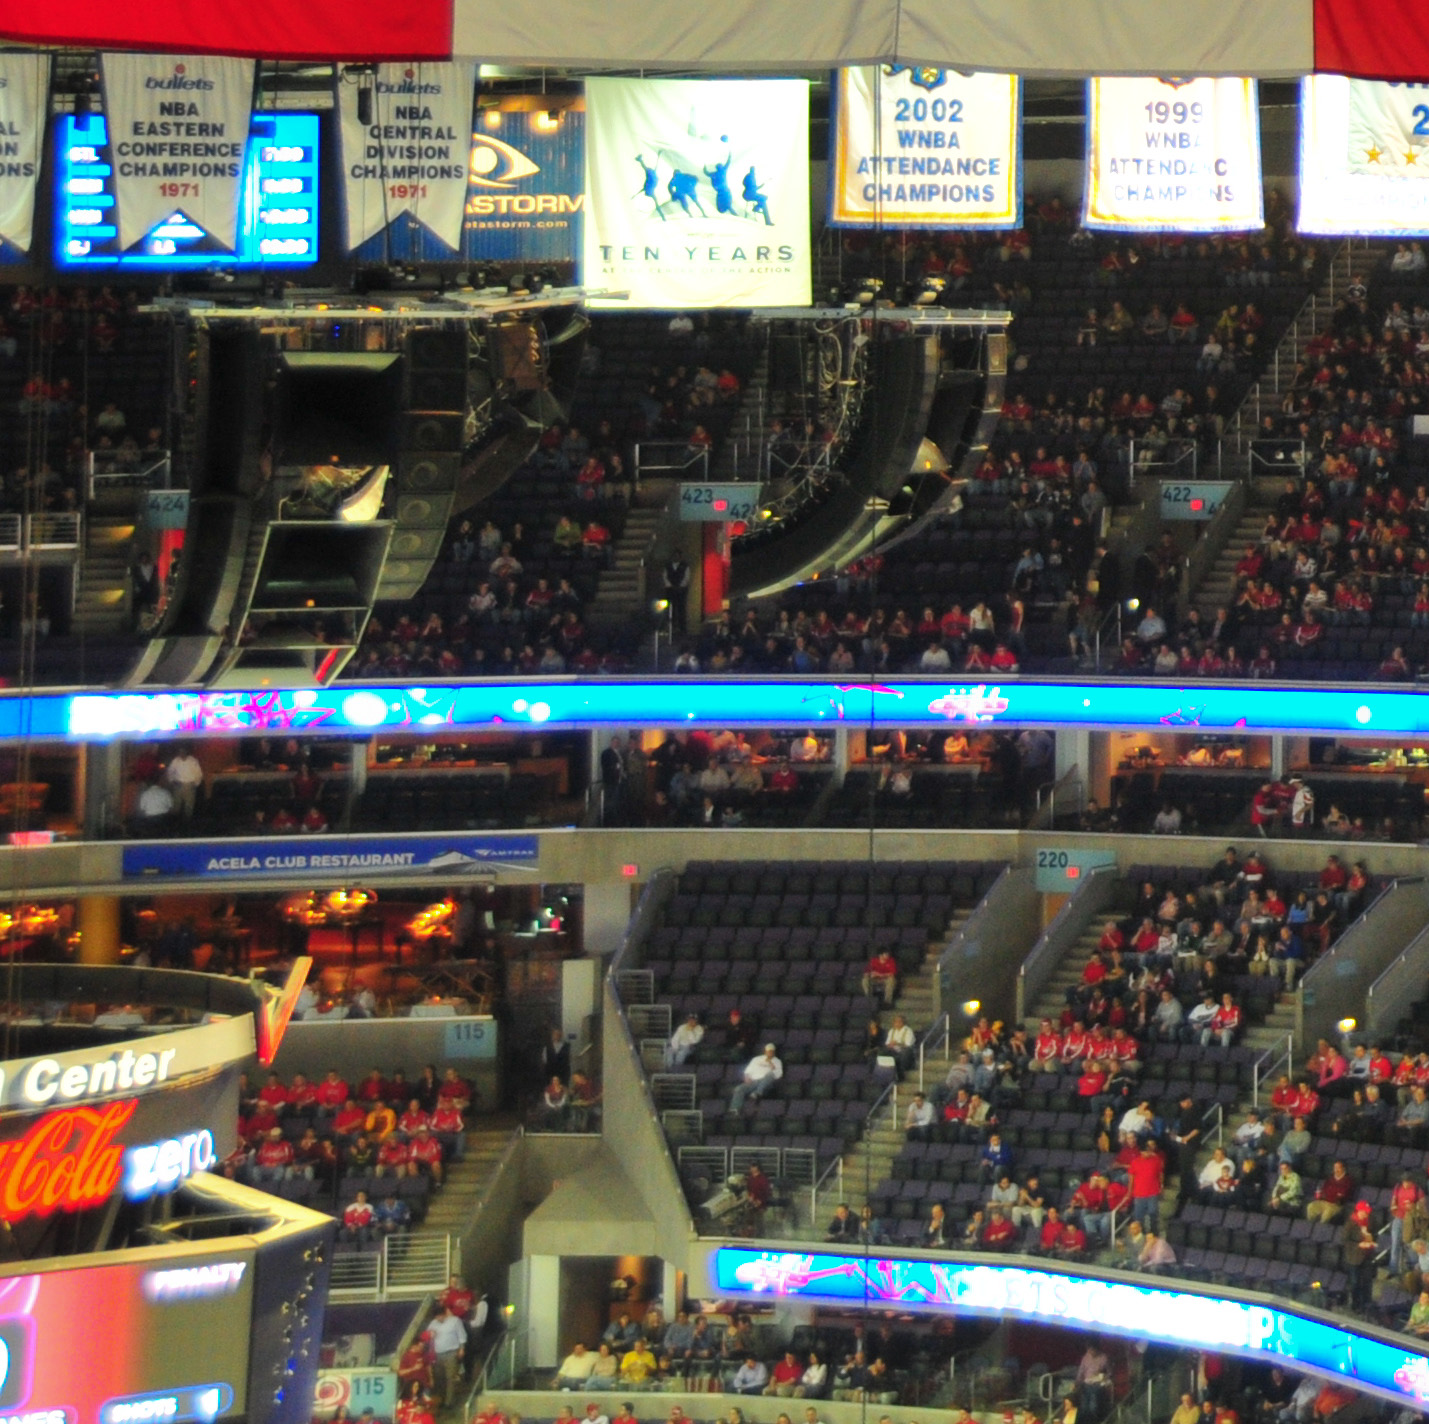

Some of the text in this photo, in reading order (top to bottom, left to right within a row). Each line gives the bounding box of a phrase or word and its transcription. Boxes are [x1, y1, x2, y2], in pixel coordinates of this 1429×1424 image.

[159, 101, 200, 117] NBA
[395, 106, 433, 121] NBA
[894, 98, 964, 123] 2002
[132, 121, 225, 138] EASTERN
[369, 125, 458, 141] CENTRAL
[897, 129, 960, 150] WNBA
[117, 141, 242, 157] CONFERENCE
[366, 145, 450, 160] DIVISION
[119, 162, 241, 178] CHAMPIONS
[351, 164, 464, 180] CHAMPIONS
[856, 155, 1001, 177] ATTENDANCE
[159, 182, 200, 198] 1971
[389, 184, 427, 199] 1971
[862, 183, 996, 203] CHAMPIONS
[599, 245, 794, 261] TEN YEARS
[681, 487, 714, 504] 423
[1160, 487, 1191, 503] 422
[208, 852, 415, 871] ACELA CLUB RESTAURANT
[1038, 851, 1069, 869] 220
[454, 1023, 486, 1041] 115
[24, 1048, 175, 1103] Center
[352, 1376, 385, 1396] 115
